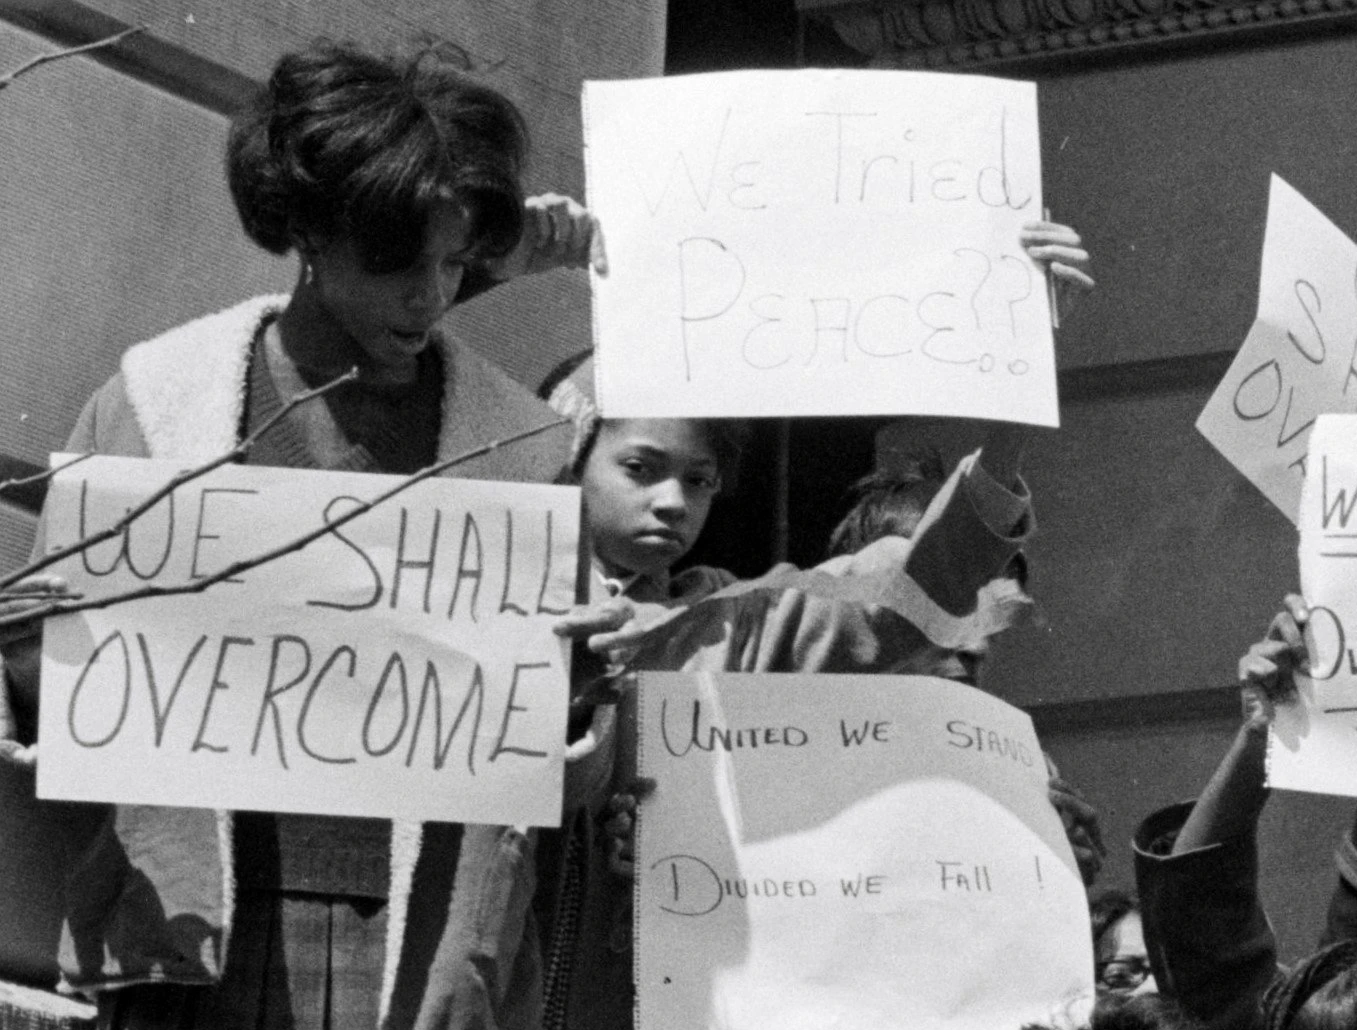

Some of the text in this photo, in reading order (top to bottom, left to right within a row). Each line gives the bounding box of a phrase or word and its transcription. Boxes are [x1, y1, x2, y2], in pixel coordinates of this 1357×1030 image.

[80, 478, 571, 622] WE SHALL
[68, 630, 551, 776] OVERCOME
[660, 699, 809, 758] UNITED
[840, 718, 892, 747] WE
[840, 873, 886, 898] WE
